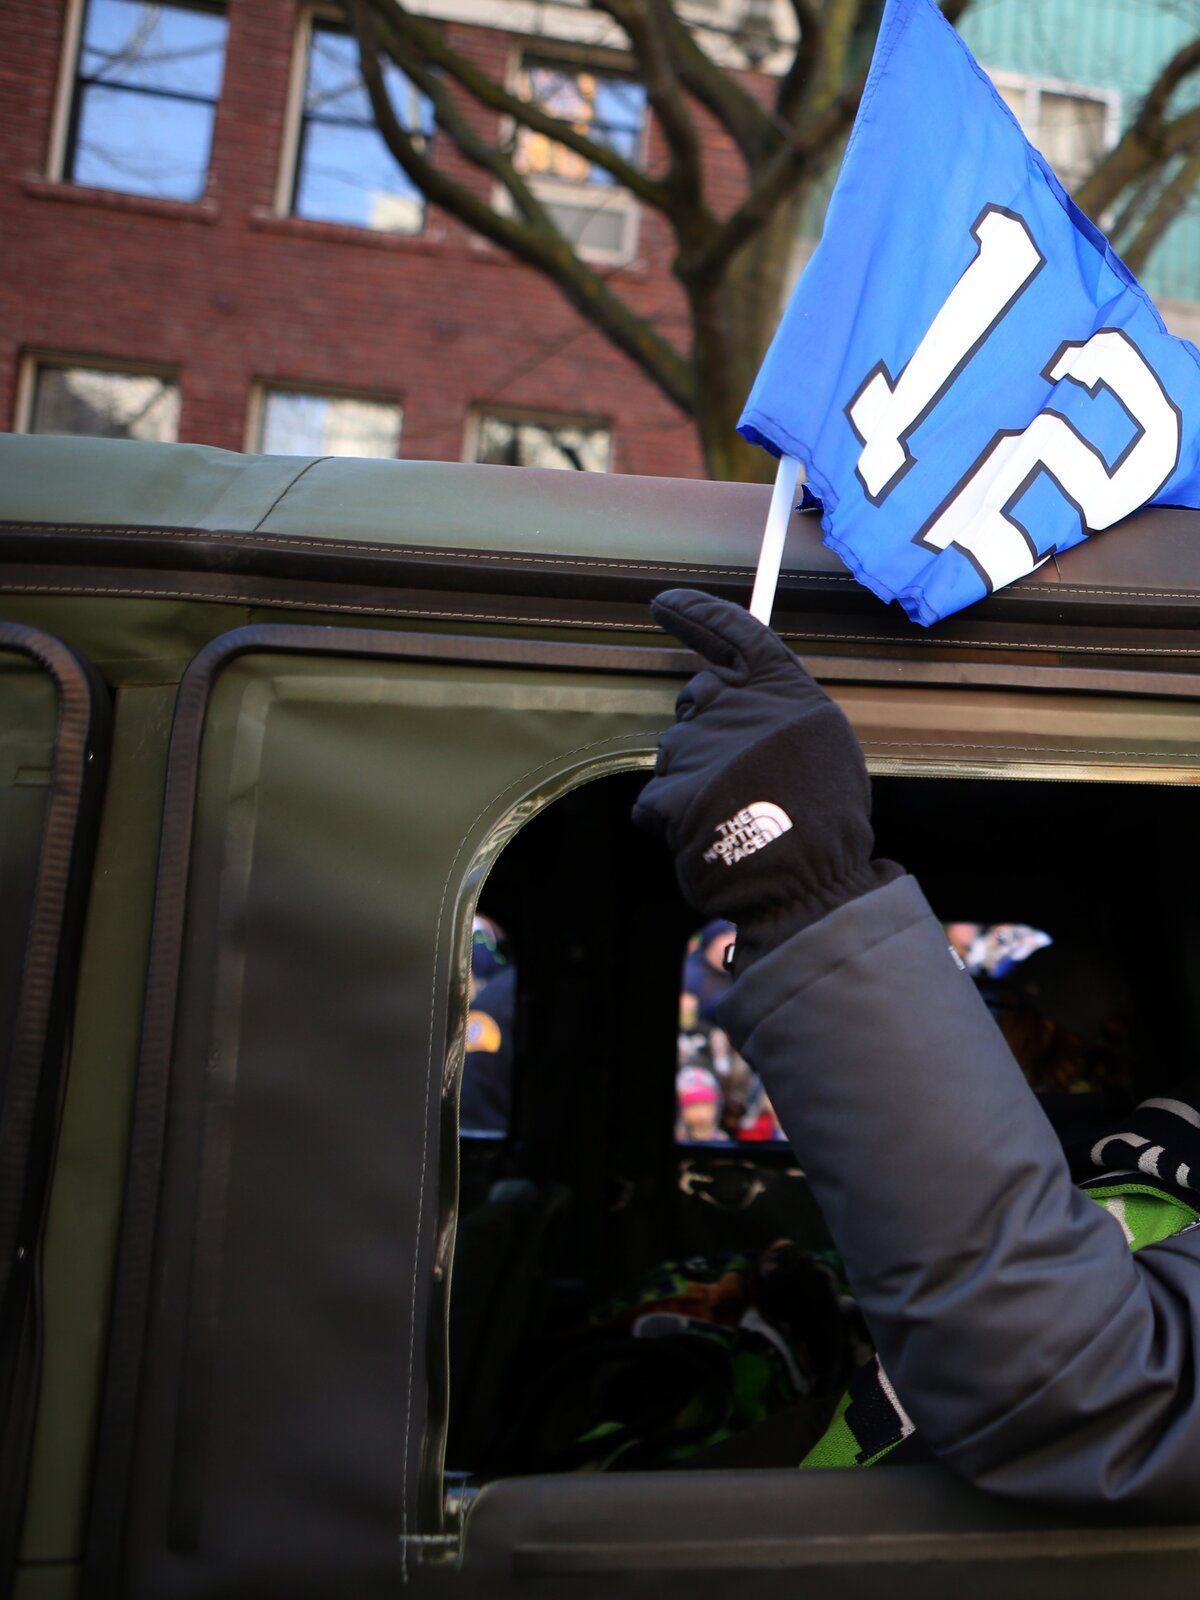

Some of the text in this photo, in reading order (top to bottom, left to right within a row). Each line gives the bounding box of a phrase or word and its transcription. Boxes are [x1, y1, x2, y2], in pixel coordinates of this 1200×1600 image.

[843, 202, 1182, 592] 12
[715, 808, 754, 836] THE
[703, 823, 761, 864] NORTH
[723, 832, 767, 866] FACE
